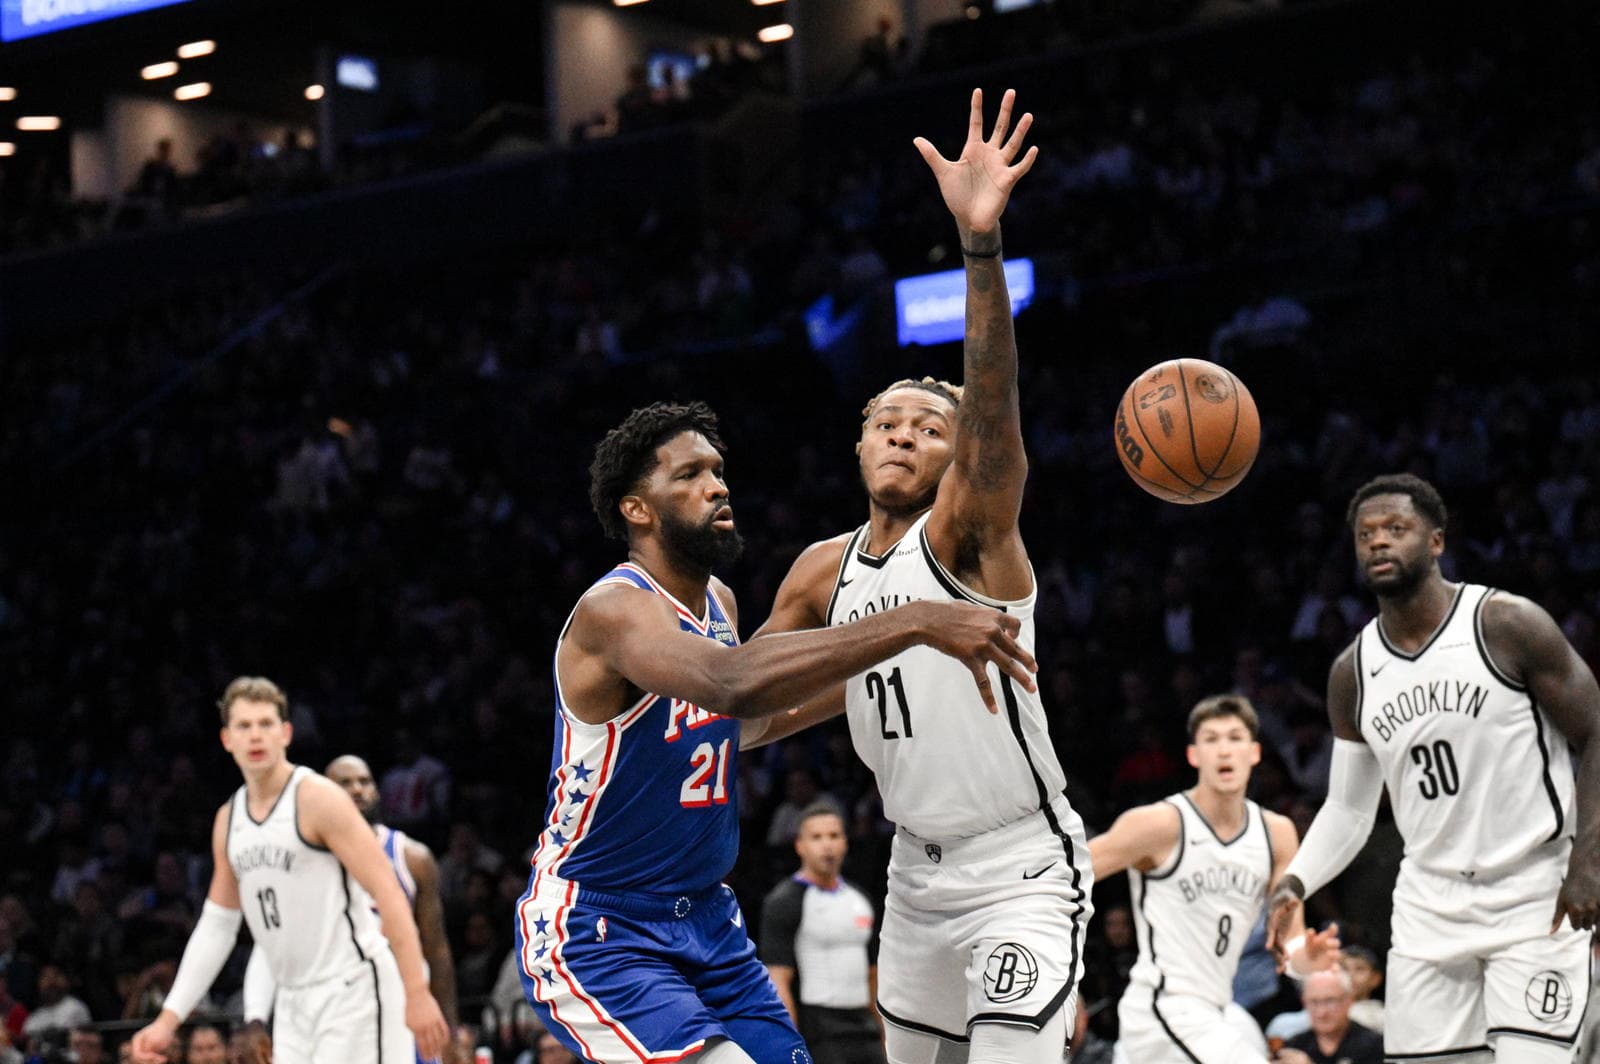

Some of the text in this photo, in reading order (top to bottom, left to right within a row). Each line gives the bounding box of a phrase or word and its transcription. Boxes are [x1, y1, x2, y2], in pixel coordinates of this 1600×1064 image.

[865, 666, 913, 739] 21
[1372, 680, 1489, 743] BROOKLYN
[680, 738, 731, 808] 21
[1411, 739, 1460, 800] 30
[1179, 865, 1262, 902] BROOKLY
[257, 885, 281, 931] 13
[1215, 914, 1232, 957] 8
[994, 952, 1018, 994] B
[1541, 978, 1559, 1015] B
